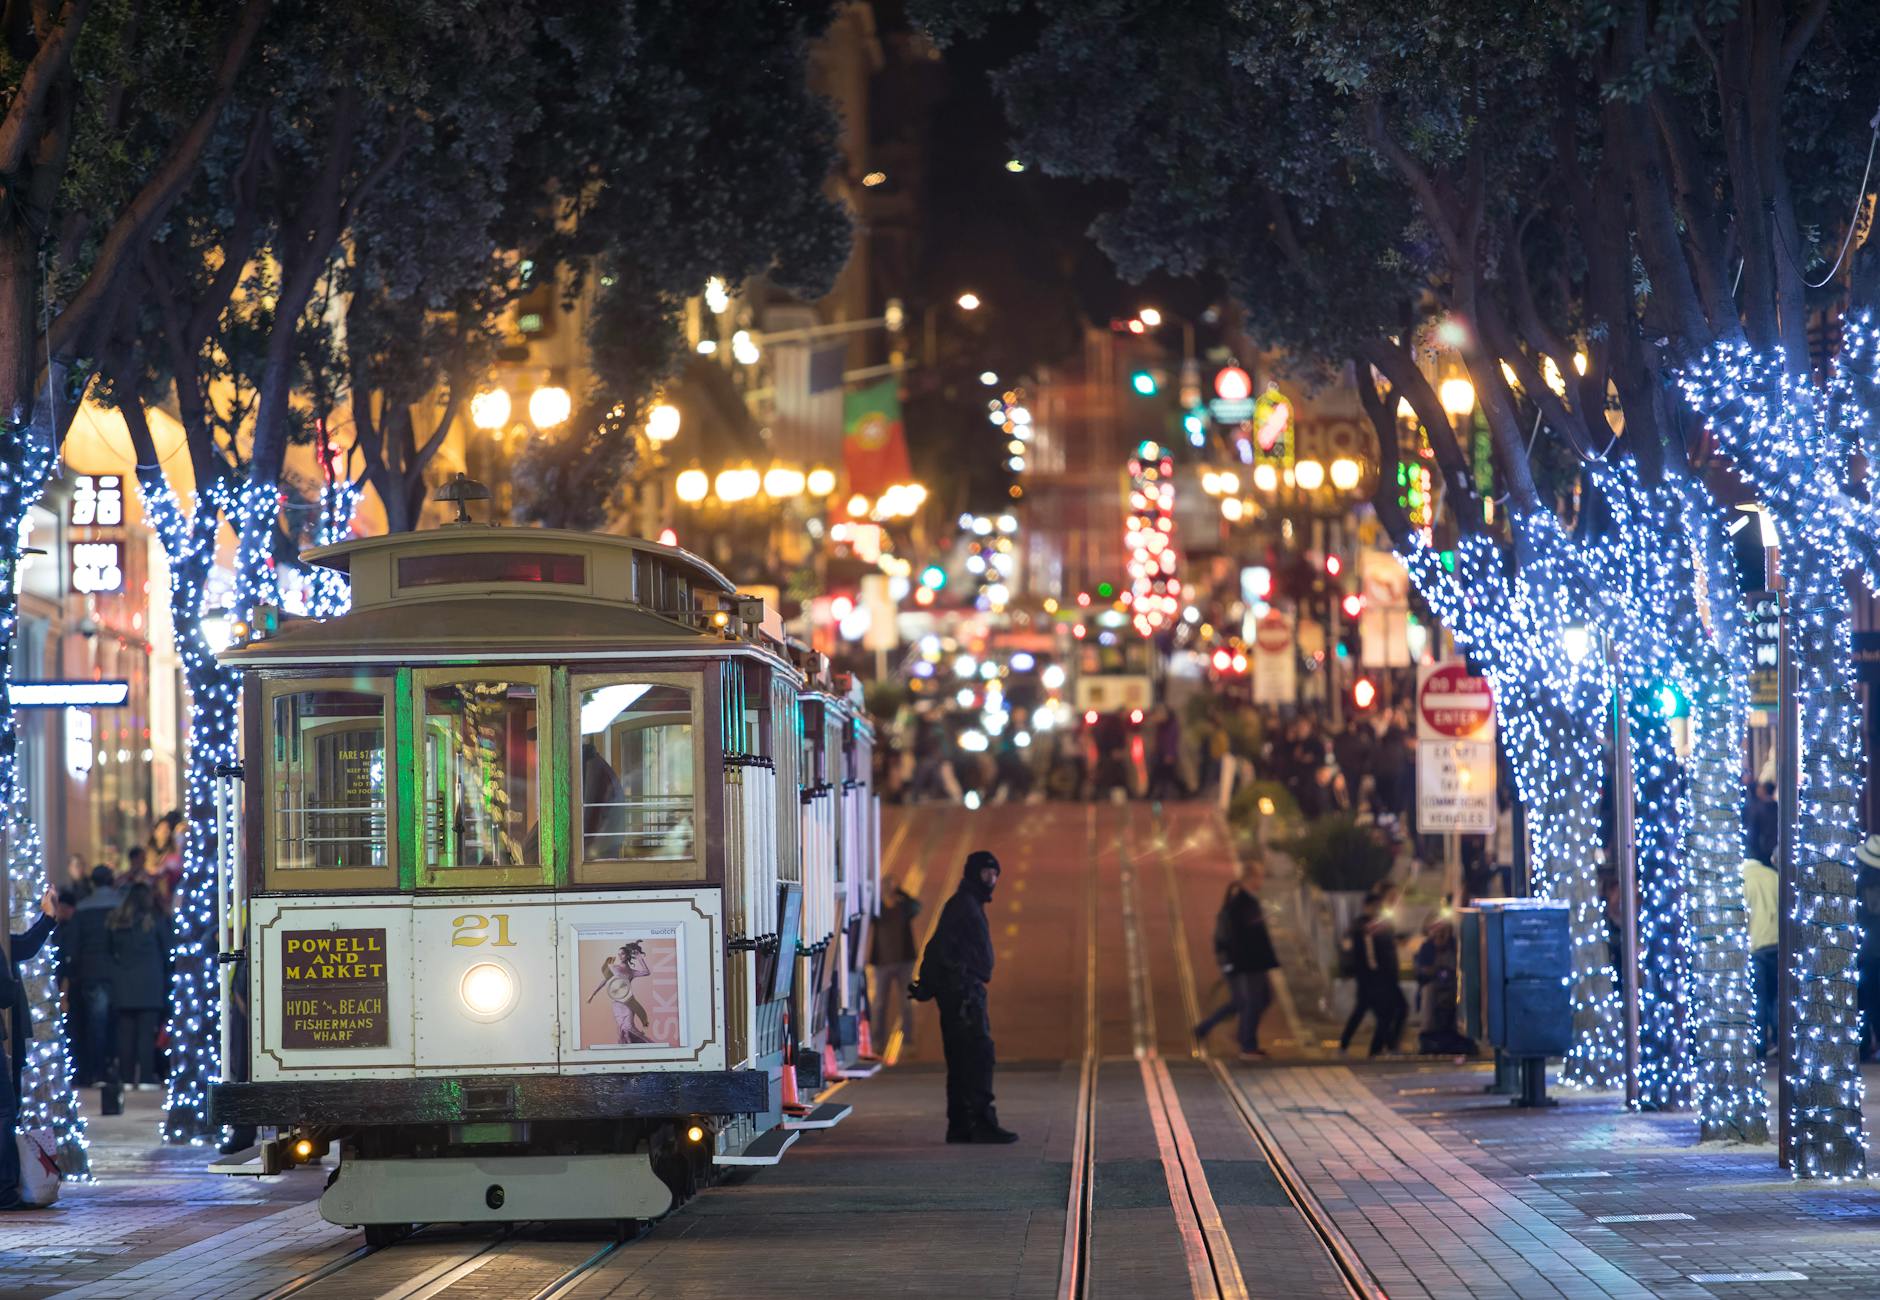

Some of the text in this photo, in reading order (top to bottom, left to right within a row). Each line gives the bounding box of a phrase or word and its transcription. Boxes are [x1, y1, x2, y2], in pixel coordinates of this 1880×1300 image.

[1429, 677, 1483, 692] DO NOT
[1434, 711, 1479, 726] ENTER
[451, 914, 518, 947] 21
[650, 927, 676, 936] swatch
[287, 937, 381, 953] POWELL
[312, 952, 359, 964] AND
[286, 964, 383, 979] MARKET
[652, 946, 678, 1040] SKIN
[286, 1000, 319, 1016] HYDE
[339, 998, 382, 1015] BEACH
[294, 1018, 373, 1031] FISHERMANS
[313, 1030, 354, 1041] WHARF
